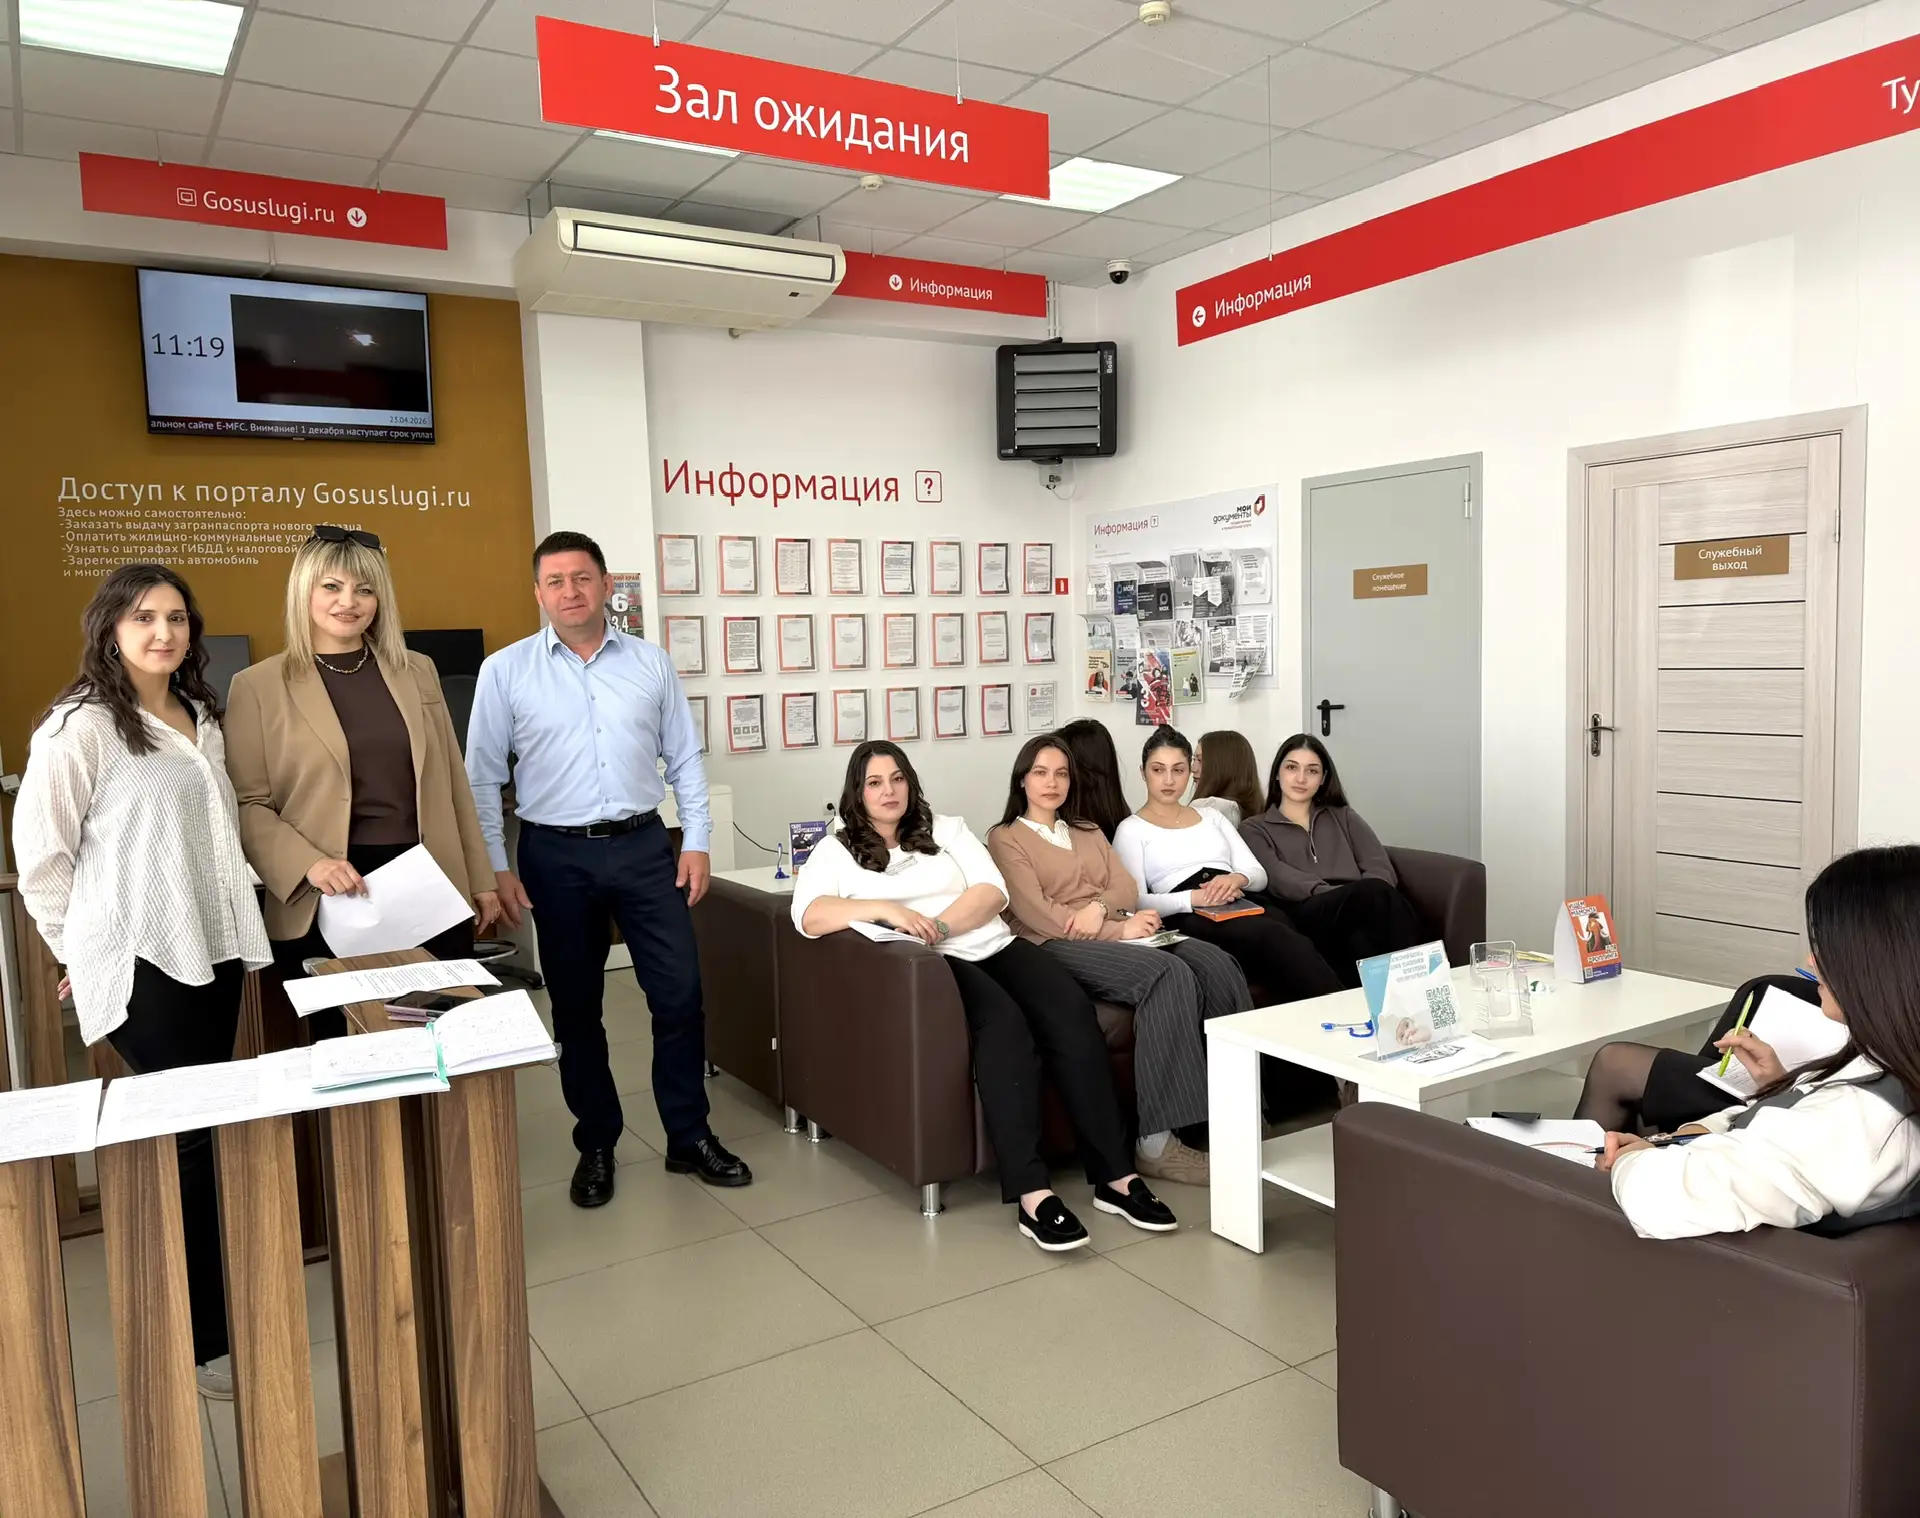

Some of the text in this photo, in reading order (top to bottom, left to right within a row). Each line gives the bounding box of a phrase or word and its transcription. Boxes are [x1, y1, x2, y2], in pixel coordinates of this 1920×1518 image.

[1881, 75, 1920, 115] Ту
[653, 64, 970, 163] Зал ожидания
[203, 190, 335, 225] Gosuslugi.ru
[910, 277, 993, 300] Информация
[1215, 274, 1313, 319] Информация
[151, 333, 225, 358] 11:19
[150, 420, 186, 429] альном
[187, 420, 214, 430] сайте
[216, 422, 248, 432] E-MFC.
[250, 423, 298, 433] Внимание!
[300, 426, 305, 434] 1
[308, 426, 344, 436] декабря
[346, 429, 388, 437] наступает
[663, 458, 899, 508] Информация
[58, 477, 471, 511] Доступ к порталу Gosuslugi.ru
[58, 506, 247, 519] Здесь можно самостоятельно:
[1236, 504, 1252, 512] мои
[59, 518, 123, 530] -Заказать
[125, 521, 171, 532] выдачу
[173, 522, 270, 533] загранпаспорта
[273, 522, 313, 531] нового
[1212, 511, 1252, 525] документы
[1093, 519, 1149, 537] Информация
[60, 531, 127, 542] -Оплатить
[129, 533, 282, 543] жилищно-коммунальные
[61, 542, 298, 555] -Узнать о штрафах ГИБДД и налоговой
[1698, 545, 1762, 560] Служебный
[62, 555, 259, 566] -Зарегистрировать автомобиль
[1712, 561, 1748, 571] выход
[63, 568, 71, 577] и
